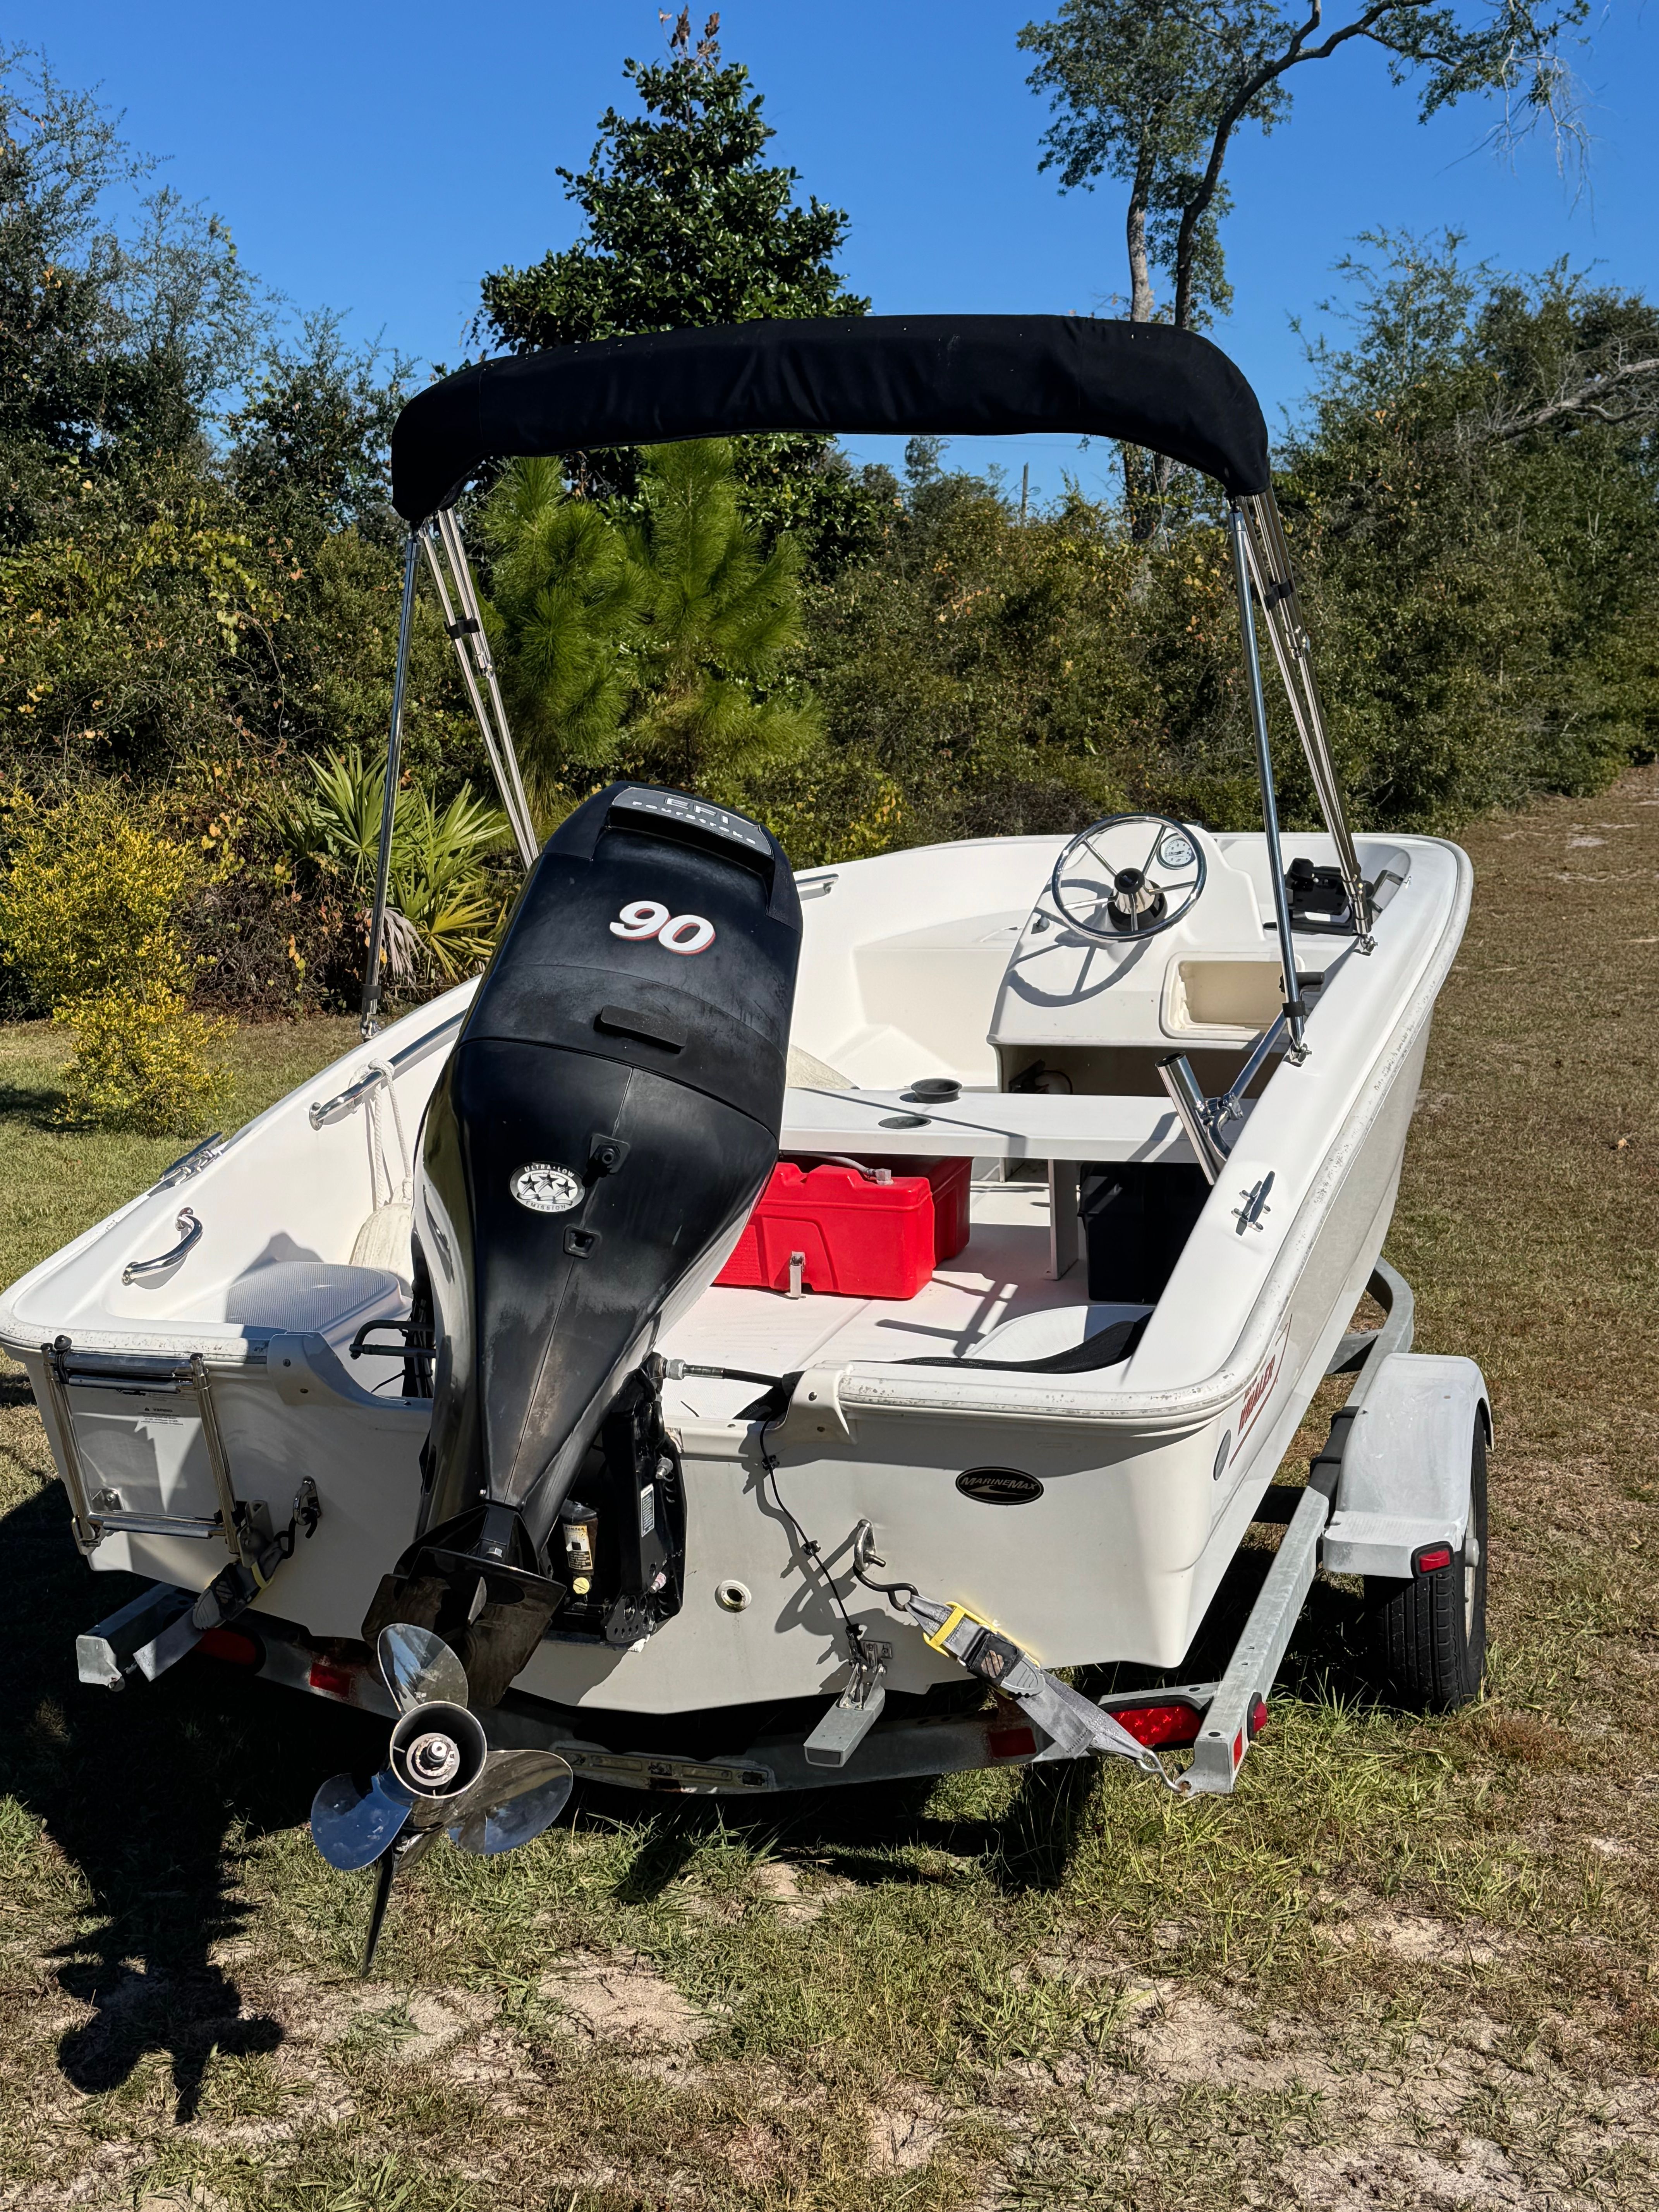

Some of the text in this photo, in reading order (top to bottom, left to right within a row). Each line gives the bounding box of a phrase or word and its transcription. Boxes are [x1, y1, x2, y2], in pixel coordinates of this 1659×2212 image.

[665, 797, 729, 824] EFI
[610, 900, 716, 956] 90
[524, 1164, 551, 1172] ULTRA
[557, 1166, 575, 1178] LOW
[526, 1200, 566, 1211] EMISSION
